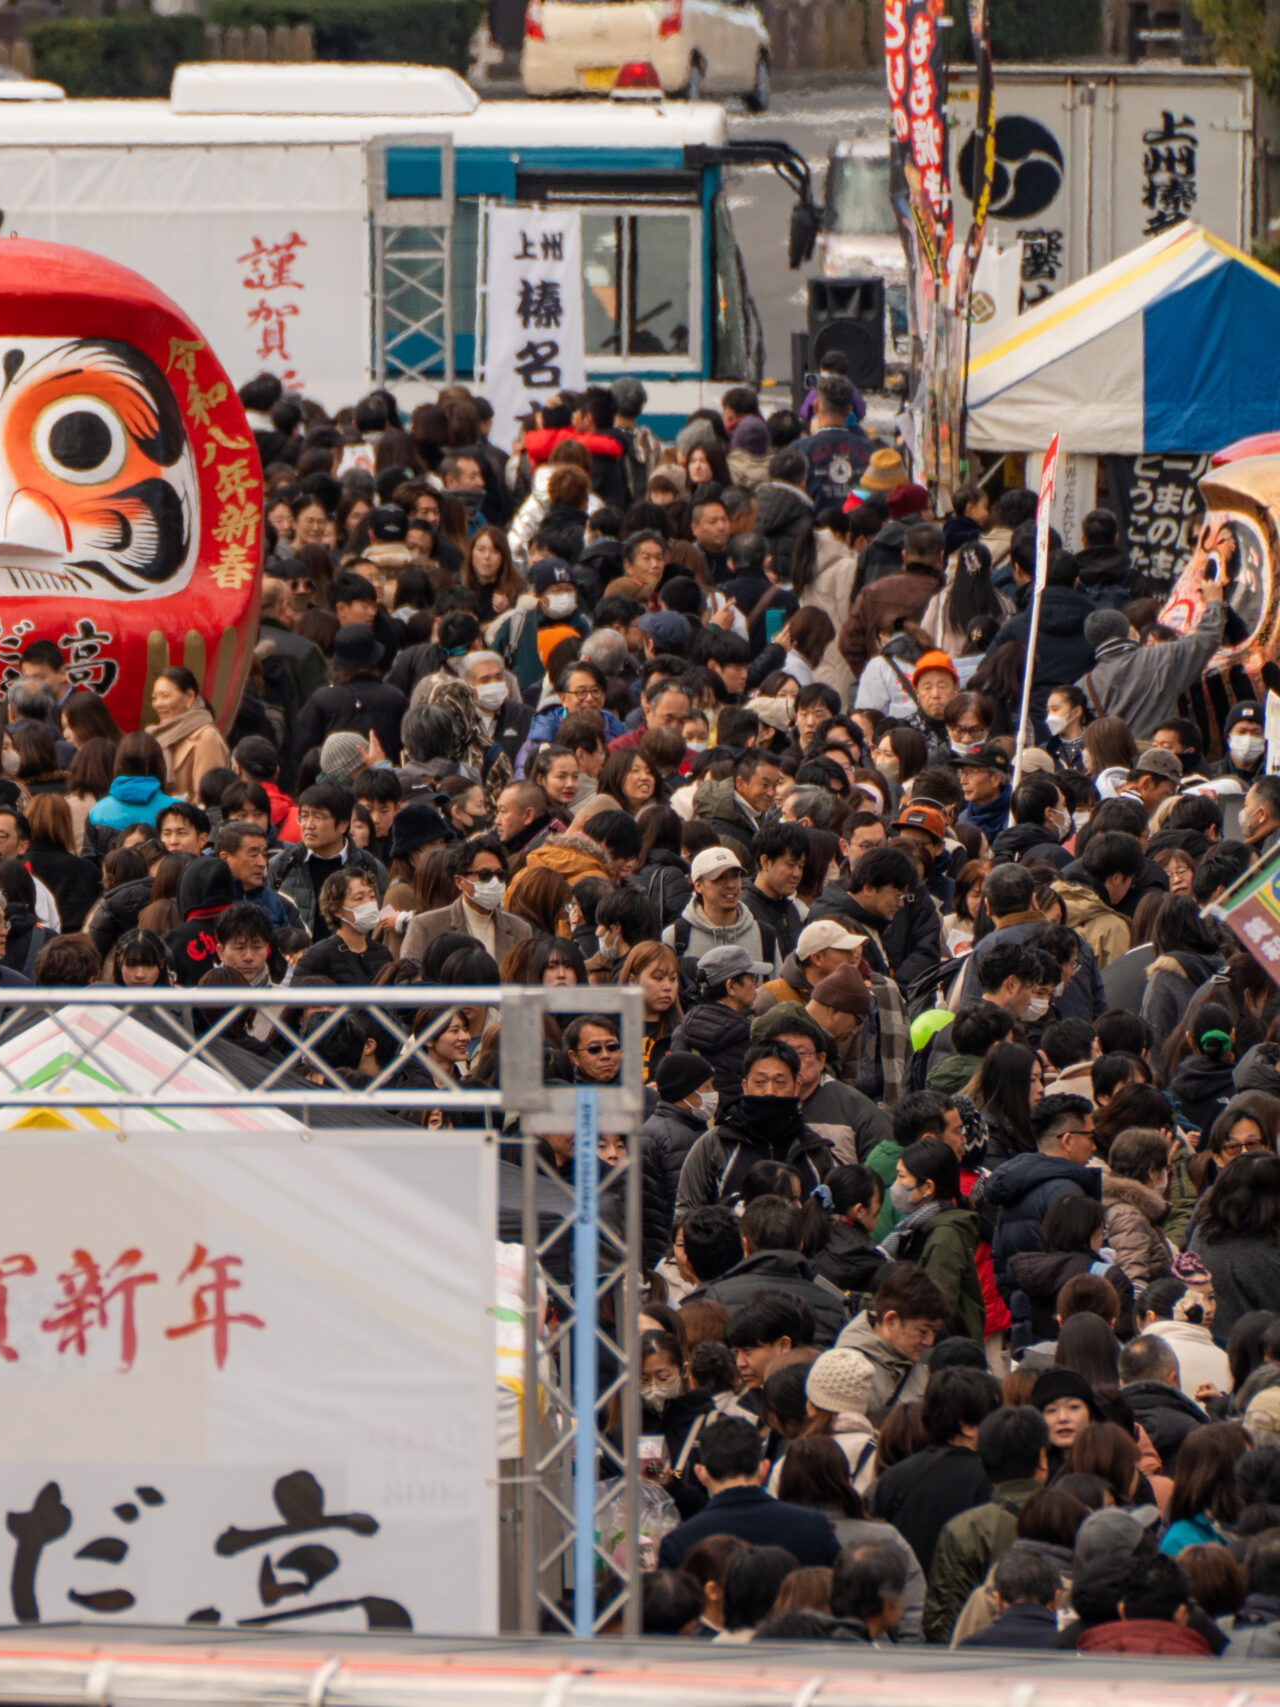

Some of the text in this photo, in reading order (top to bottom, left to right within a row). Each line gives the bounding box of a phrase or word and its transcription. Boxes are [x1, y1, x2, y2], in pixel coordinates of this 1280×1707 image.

[513, 231, 565, 261] 上州
[236, 232, 308, 390] 謹賀
[166, 336, 262, 590] 令和八年新春
[59, 616, 119, 698] 高
